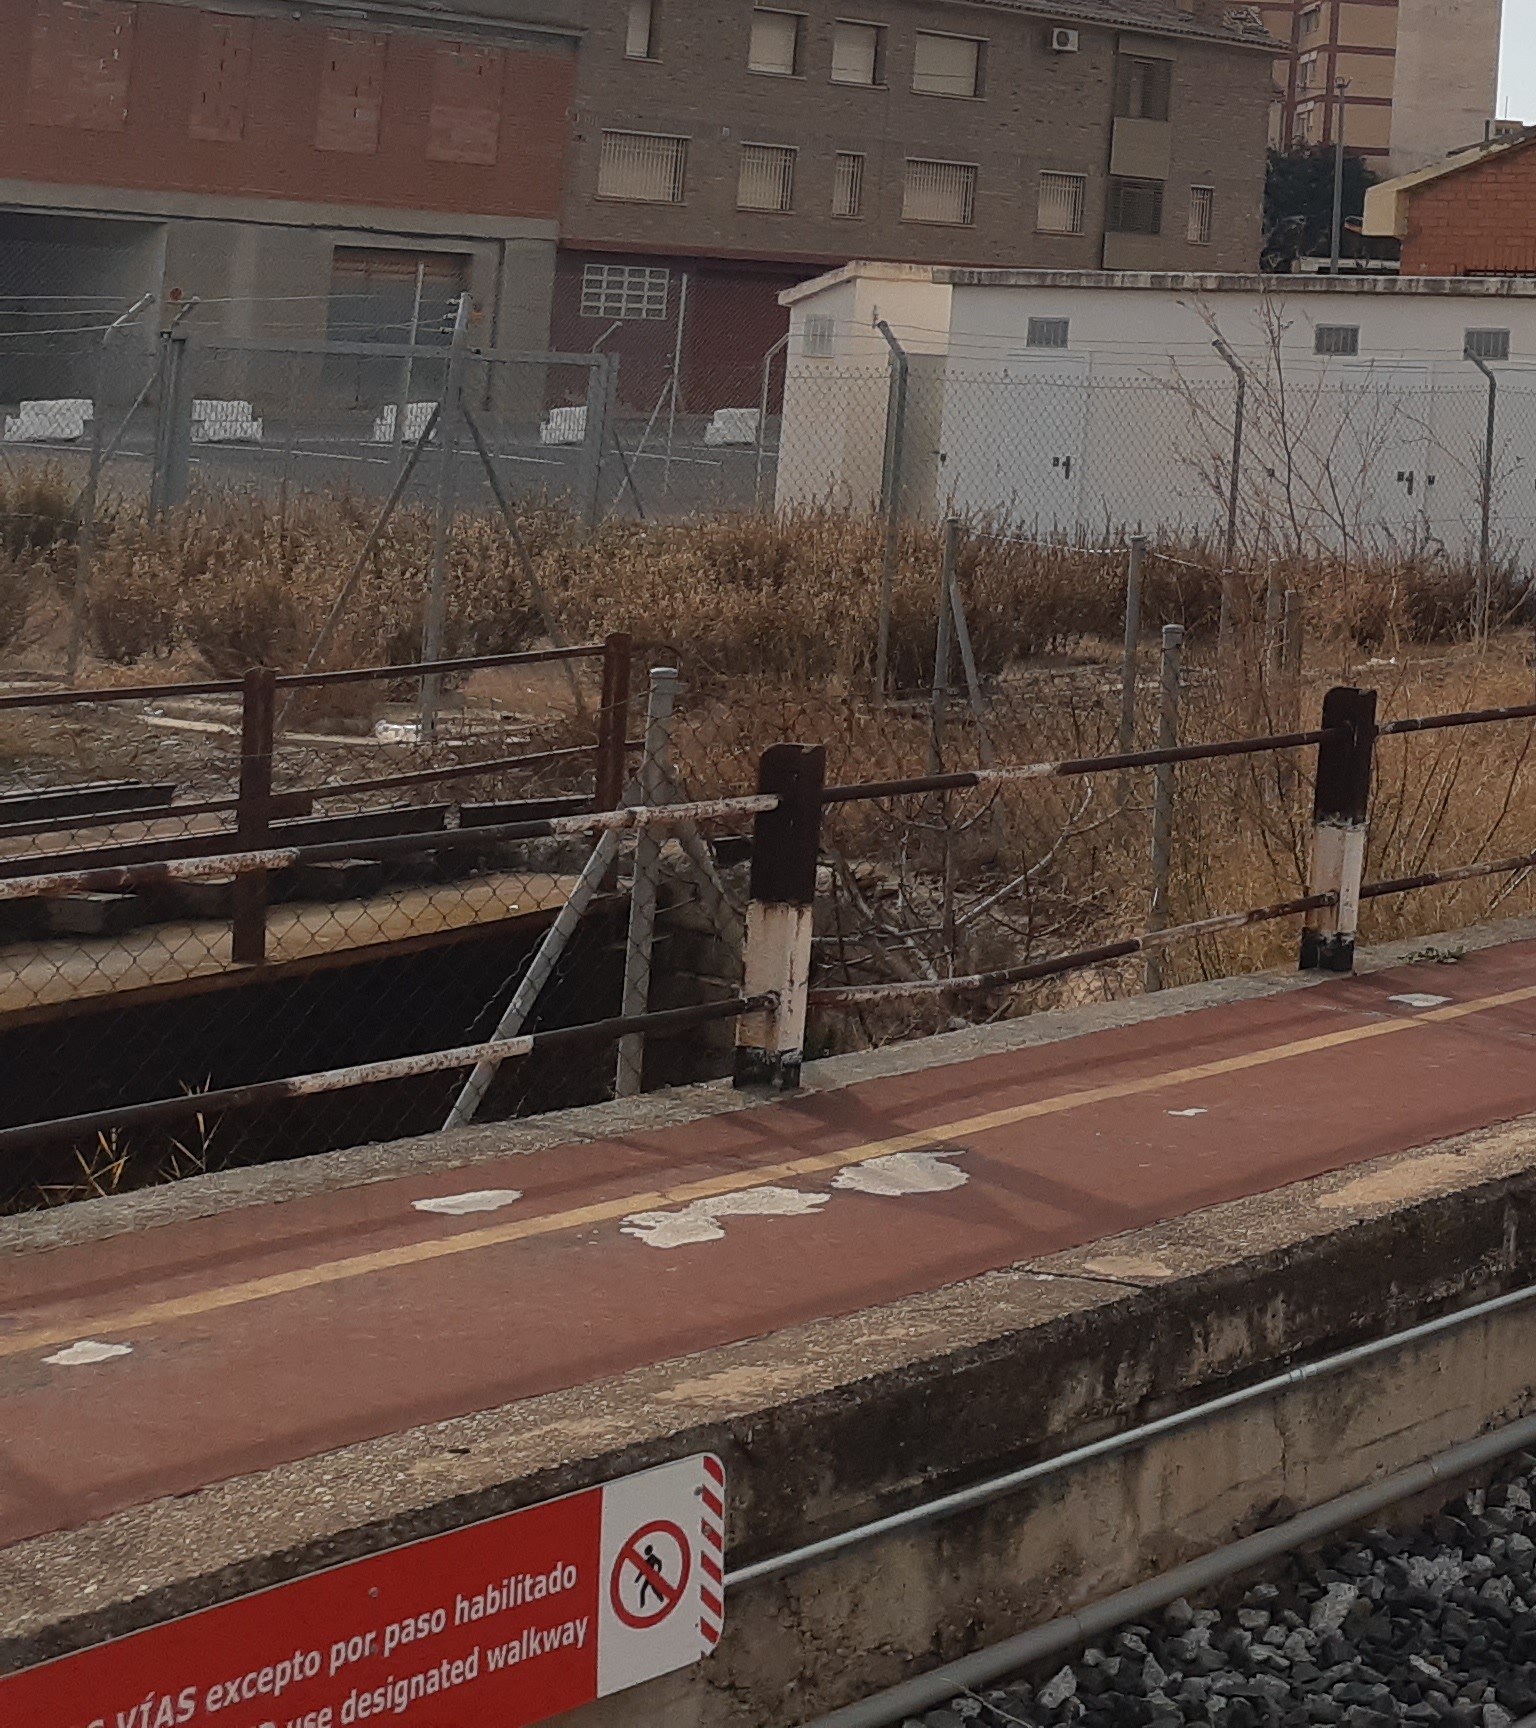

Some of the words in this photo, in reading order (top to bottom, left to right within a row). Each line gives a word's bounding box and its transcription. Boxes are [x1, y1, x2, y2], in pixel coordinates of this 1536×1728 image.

[205, 1649, 321, 1713] excepto
[329, 1632, 376, 1678] por
[384, 1608, 446, 1658] paso
[454, 1561, 577, 1626] habilitado
[340, 1646, 480, 1724] designated
[486, 1616, 589, 1673] walkway
